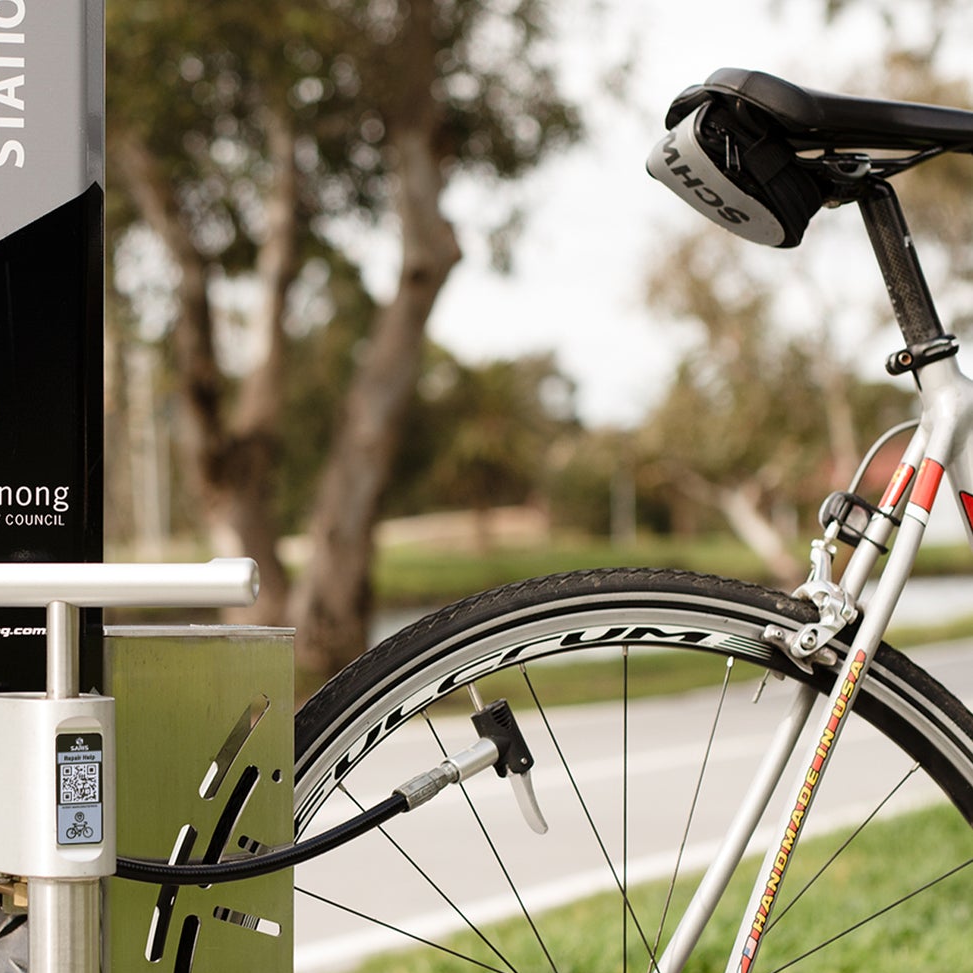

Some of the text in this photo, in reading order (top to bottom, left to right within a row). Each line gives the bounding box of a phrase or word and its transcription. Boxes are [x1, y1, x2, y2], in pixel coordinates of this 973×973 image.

[5, 513, 65, 526] COUNCIL
[752, 658, 864, 933] HANDMADE IN USA
